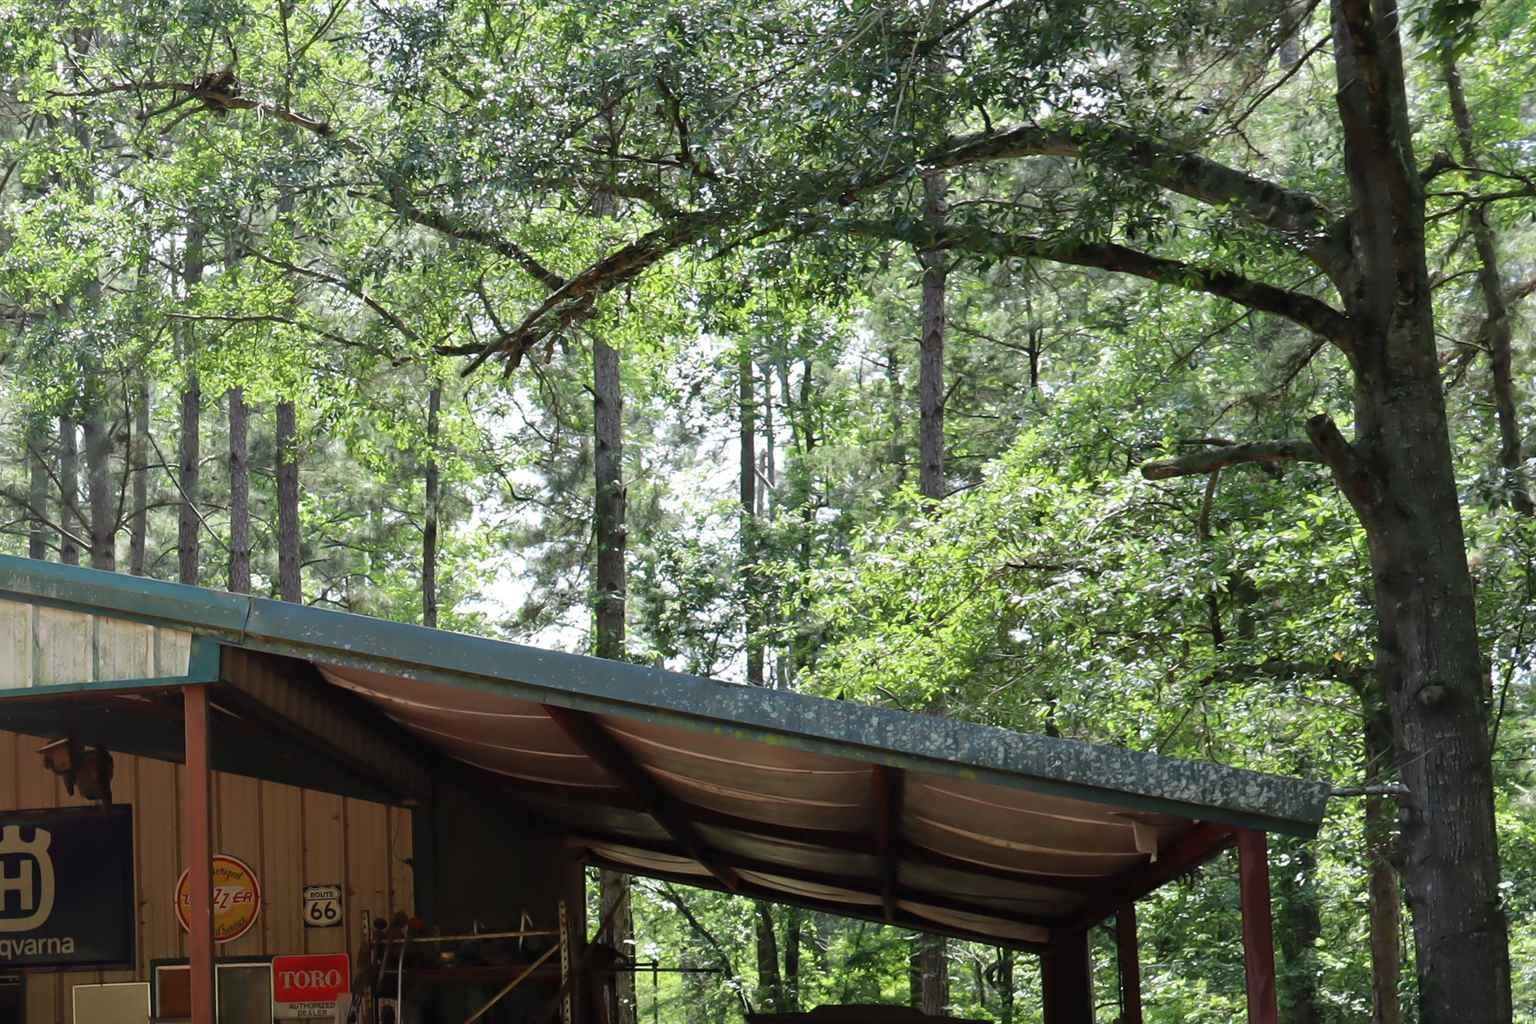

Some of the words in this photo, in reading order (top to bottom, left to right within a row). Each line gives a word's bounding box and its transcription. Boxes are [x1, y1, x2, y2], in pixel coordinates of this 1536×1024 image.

[310, 890, 333, 898] ROUTE
[311, 901, 336, 920] 66
[279, 969, 342, 990] TORO
